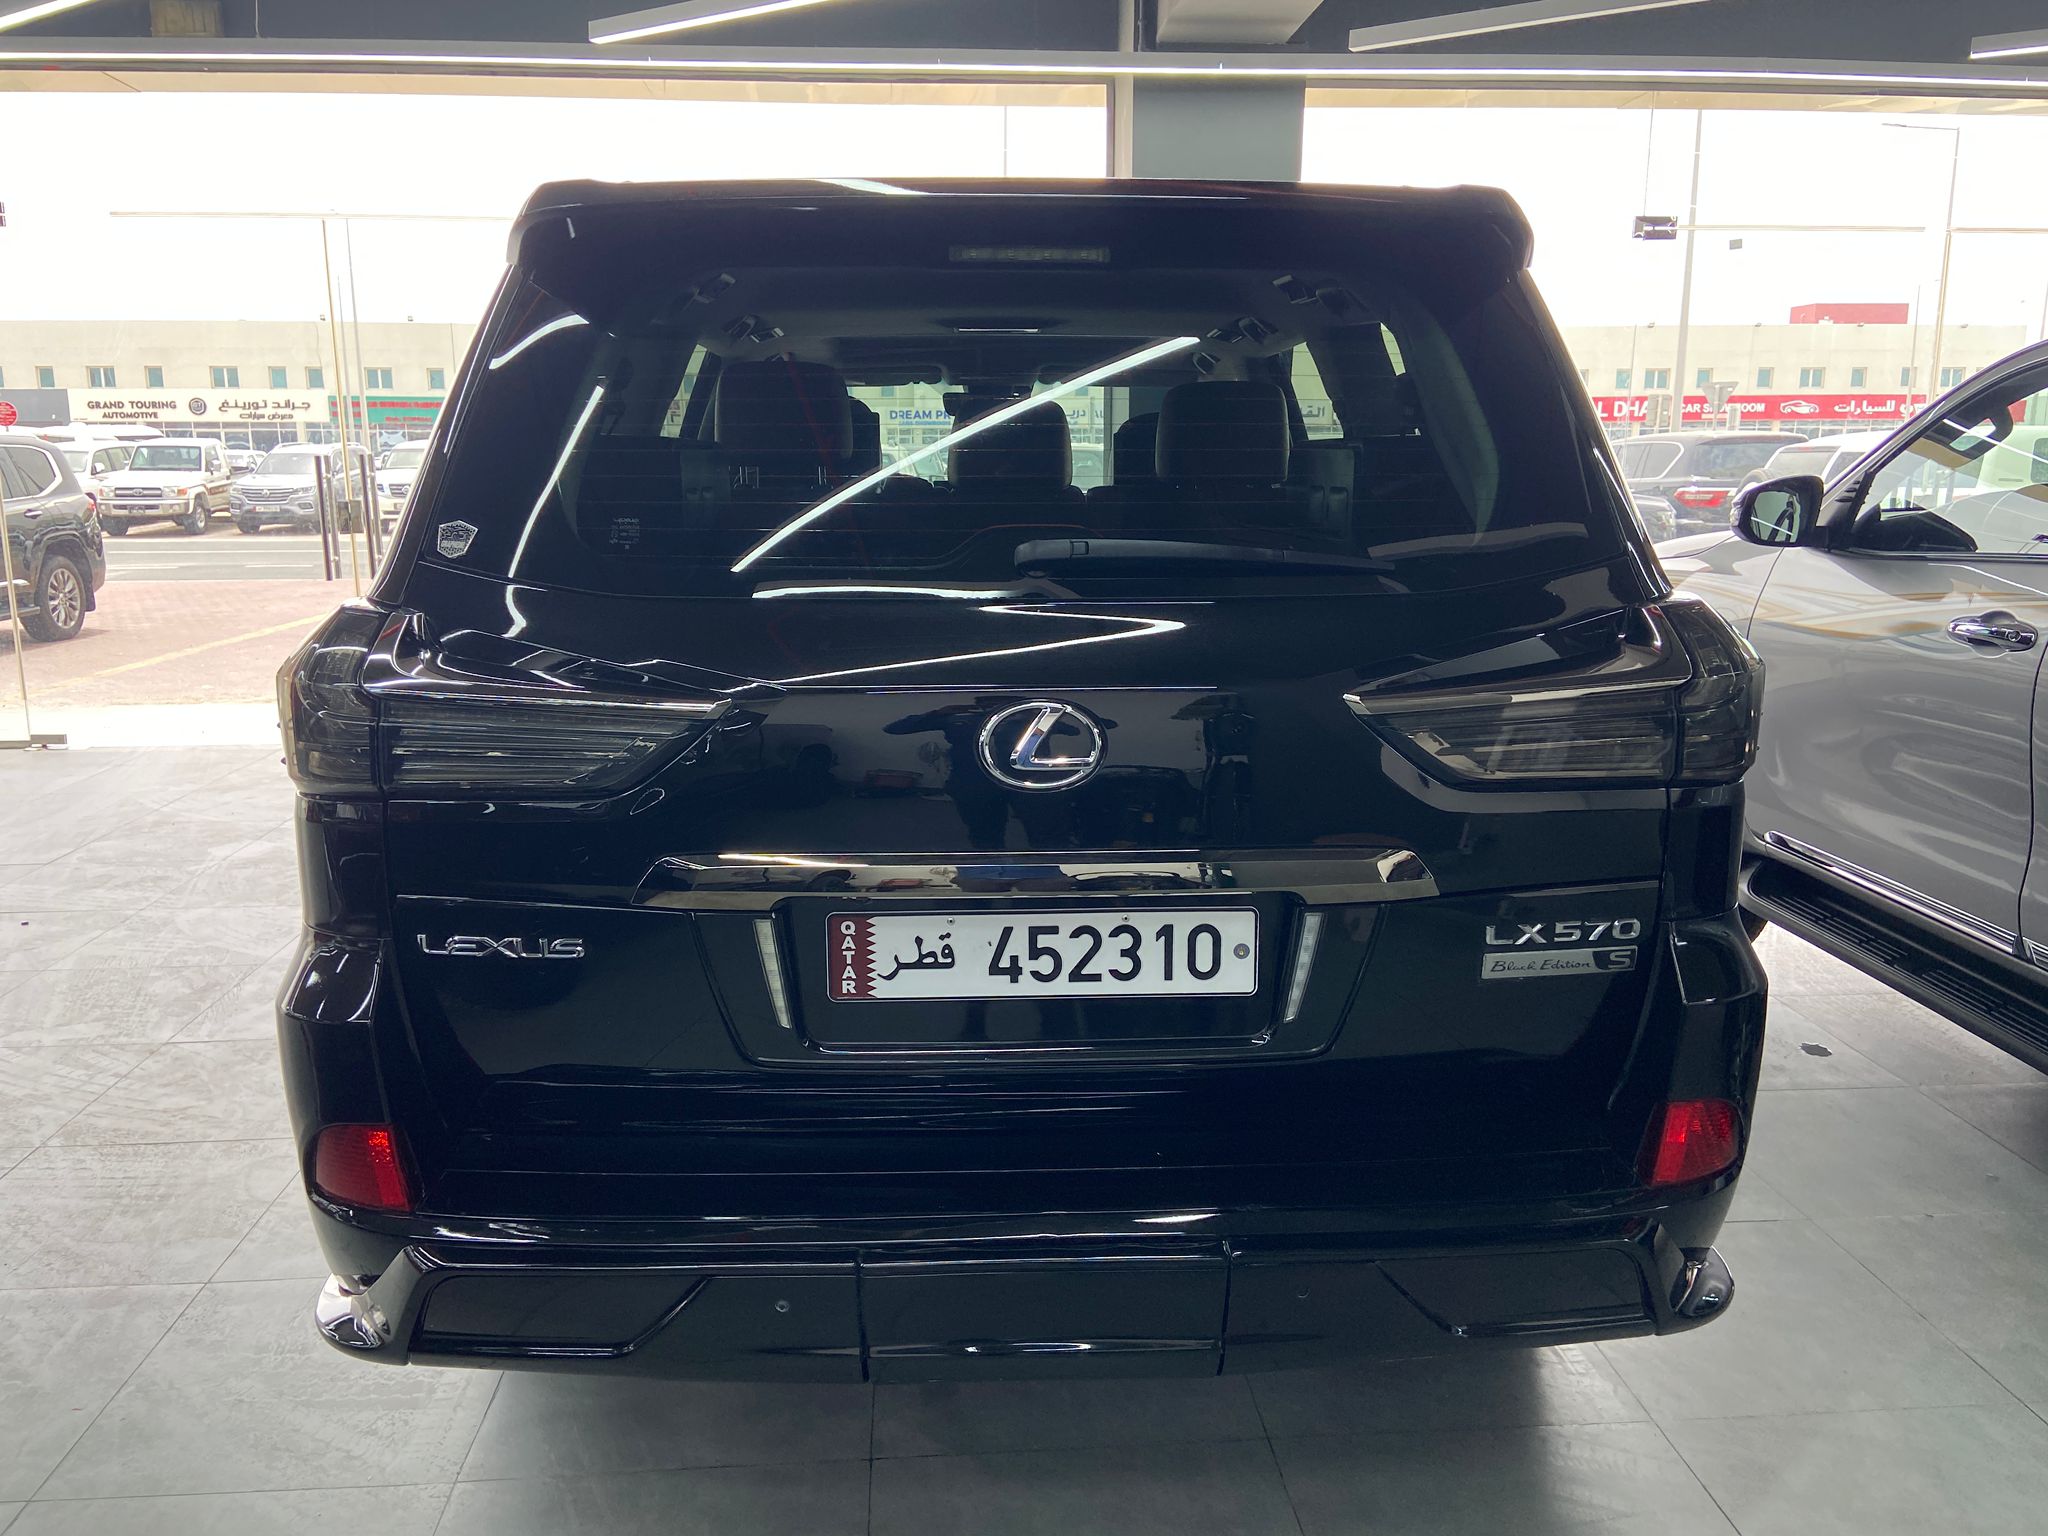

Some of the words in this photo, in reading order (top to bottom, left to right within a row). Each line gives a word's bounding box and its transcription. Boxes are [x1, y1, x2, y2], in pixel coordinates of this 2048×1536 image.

[87, 400, 124, 410] GRAND
[129, 400, 177, 410] TOURING
[102, 411, 158, 419] AUTOMOTIVE
[890, 410, 932, 419] DREAM
[1834, 400, 1895, 414] للسيارات
[416, 934, 585, 958] LEXUS
[840, 920, 857, 994] QATAR
[877, 932, 956, 981] قطر
[988, 923, 1222, 984] 452310
[1490, 960, 1537, 973] Black
[1540, 959, 1592, 971] Edition
[1608, 951, 1632, 969] S
